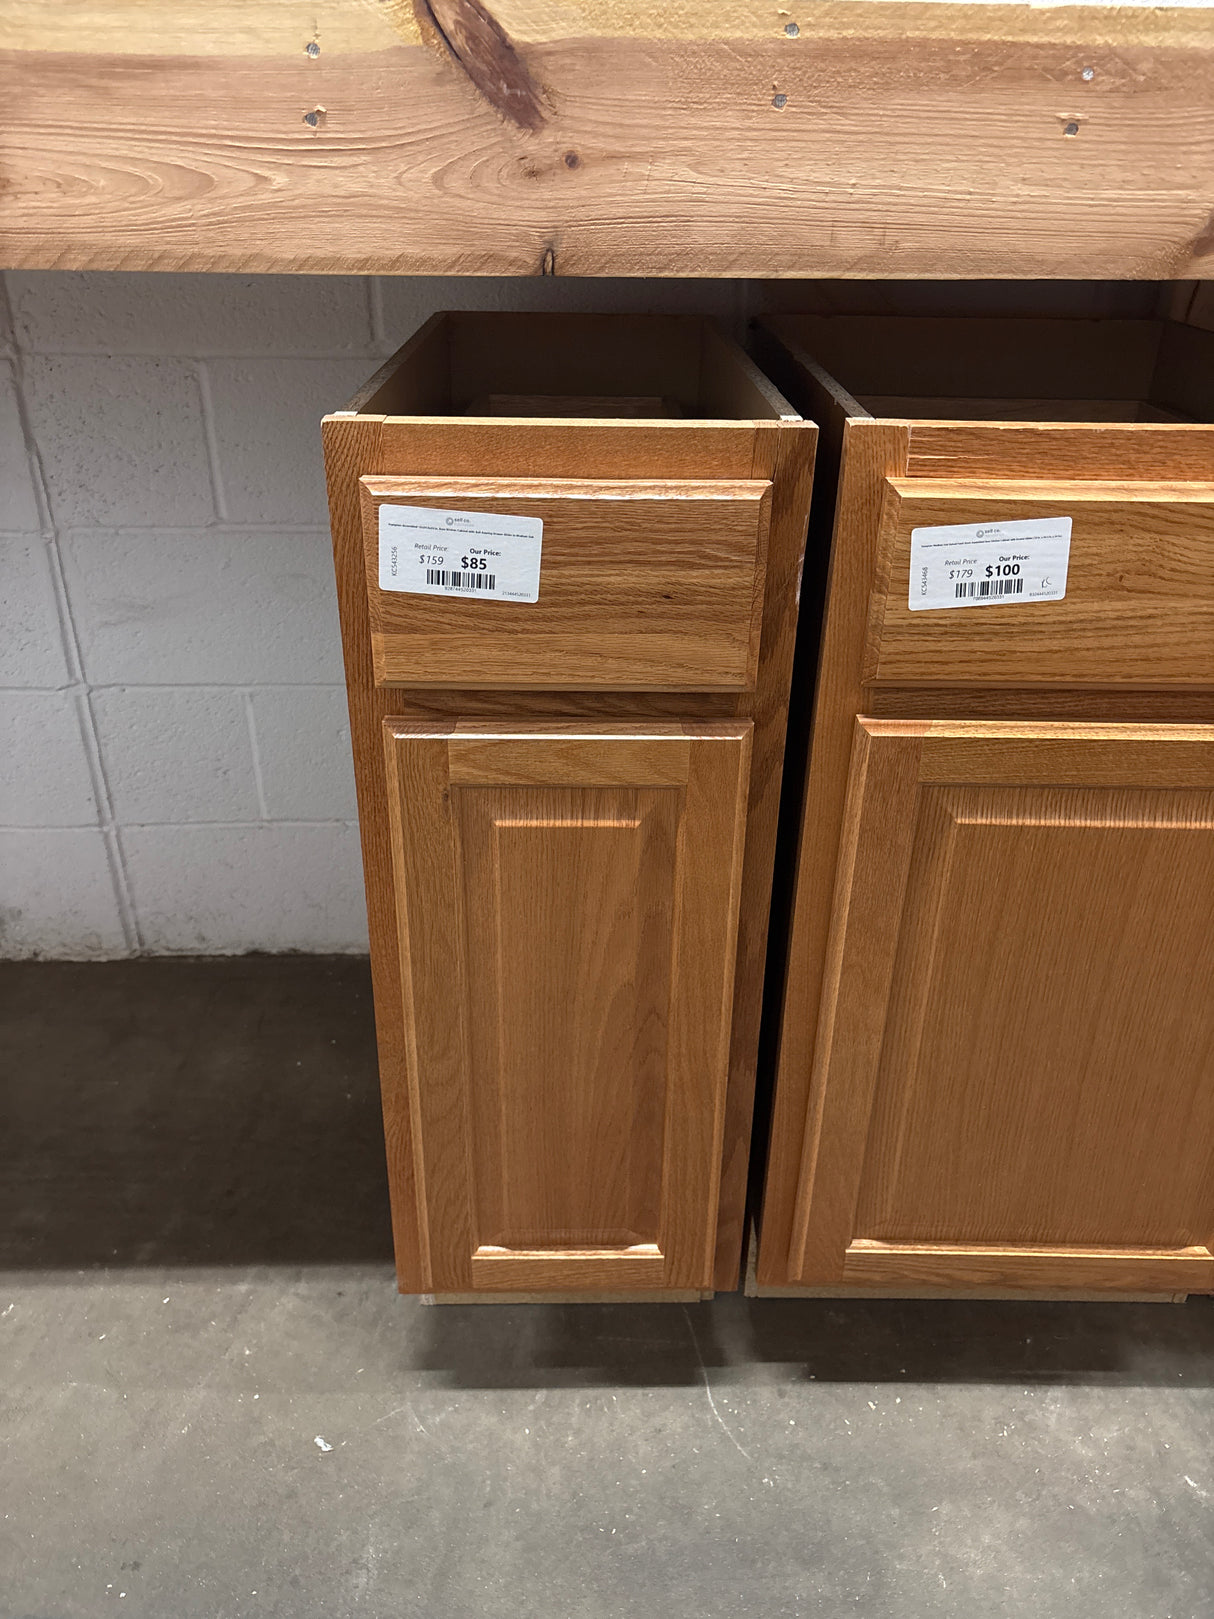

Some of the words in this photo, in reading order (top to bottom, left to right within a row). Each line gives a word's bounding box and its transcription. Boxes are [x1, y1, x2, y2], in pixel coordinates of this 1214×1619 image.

[414, 543, 432, 551] Retail
[483, 549, 502, 557] Price:
[1012, 554, 1030, 562] Price:
[419, 554, 444, 566] $159
[461, 555, 487, 570] $85
[949, 568, 973, 579] $179
[985, 563, 1021, 578] $100
